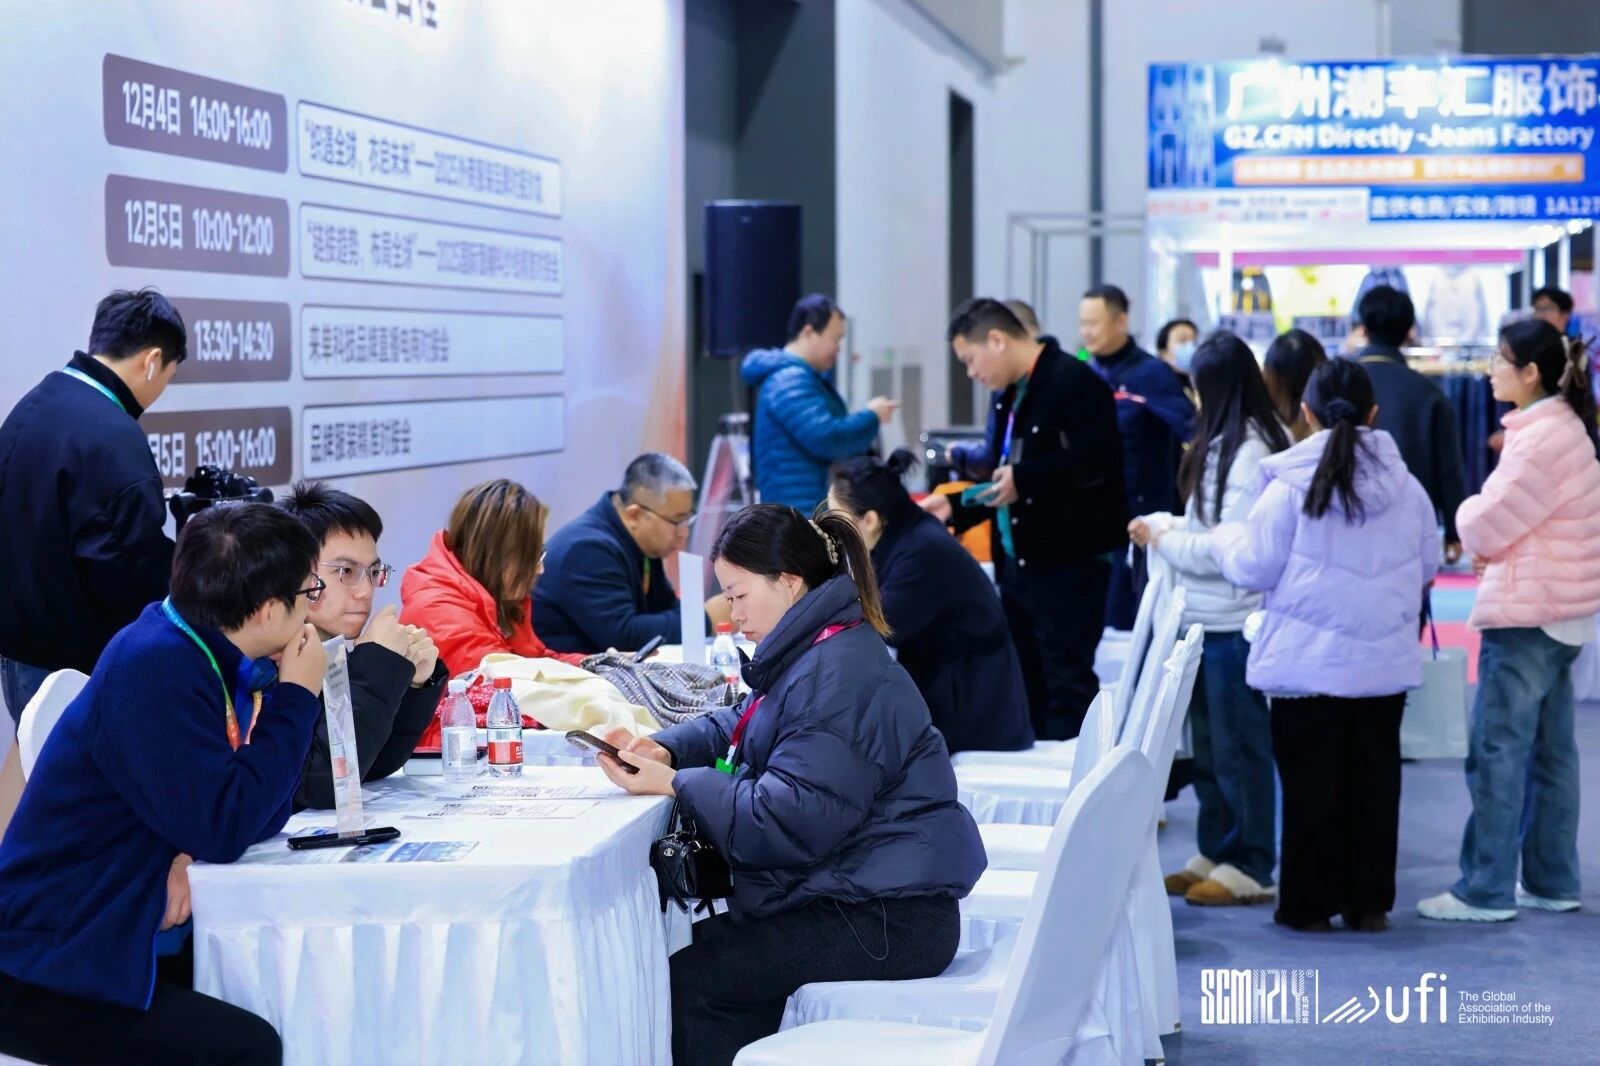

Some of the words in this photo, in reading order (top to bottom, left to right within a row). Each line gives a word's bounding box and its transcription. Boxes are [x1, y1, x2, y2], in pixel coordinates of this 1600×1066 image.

[122, 81, 181, 136] 12月4日
[190, 96, 272, 150] 14:00-16:00
[1318, 123, 1415, 152] Directly
[1501, 123, 1595, 151] Factory
[125, 200, 183, 250] 12月5日
[192, 208, 274, 256] 10:00-12:00
[194, 320, 275, 362] 13:30-14:30
[195, 427, 277, 470] 15:00-16:00
